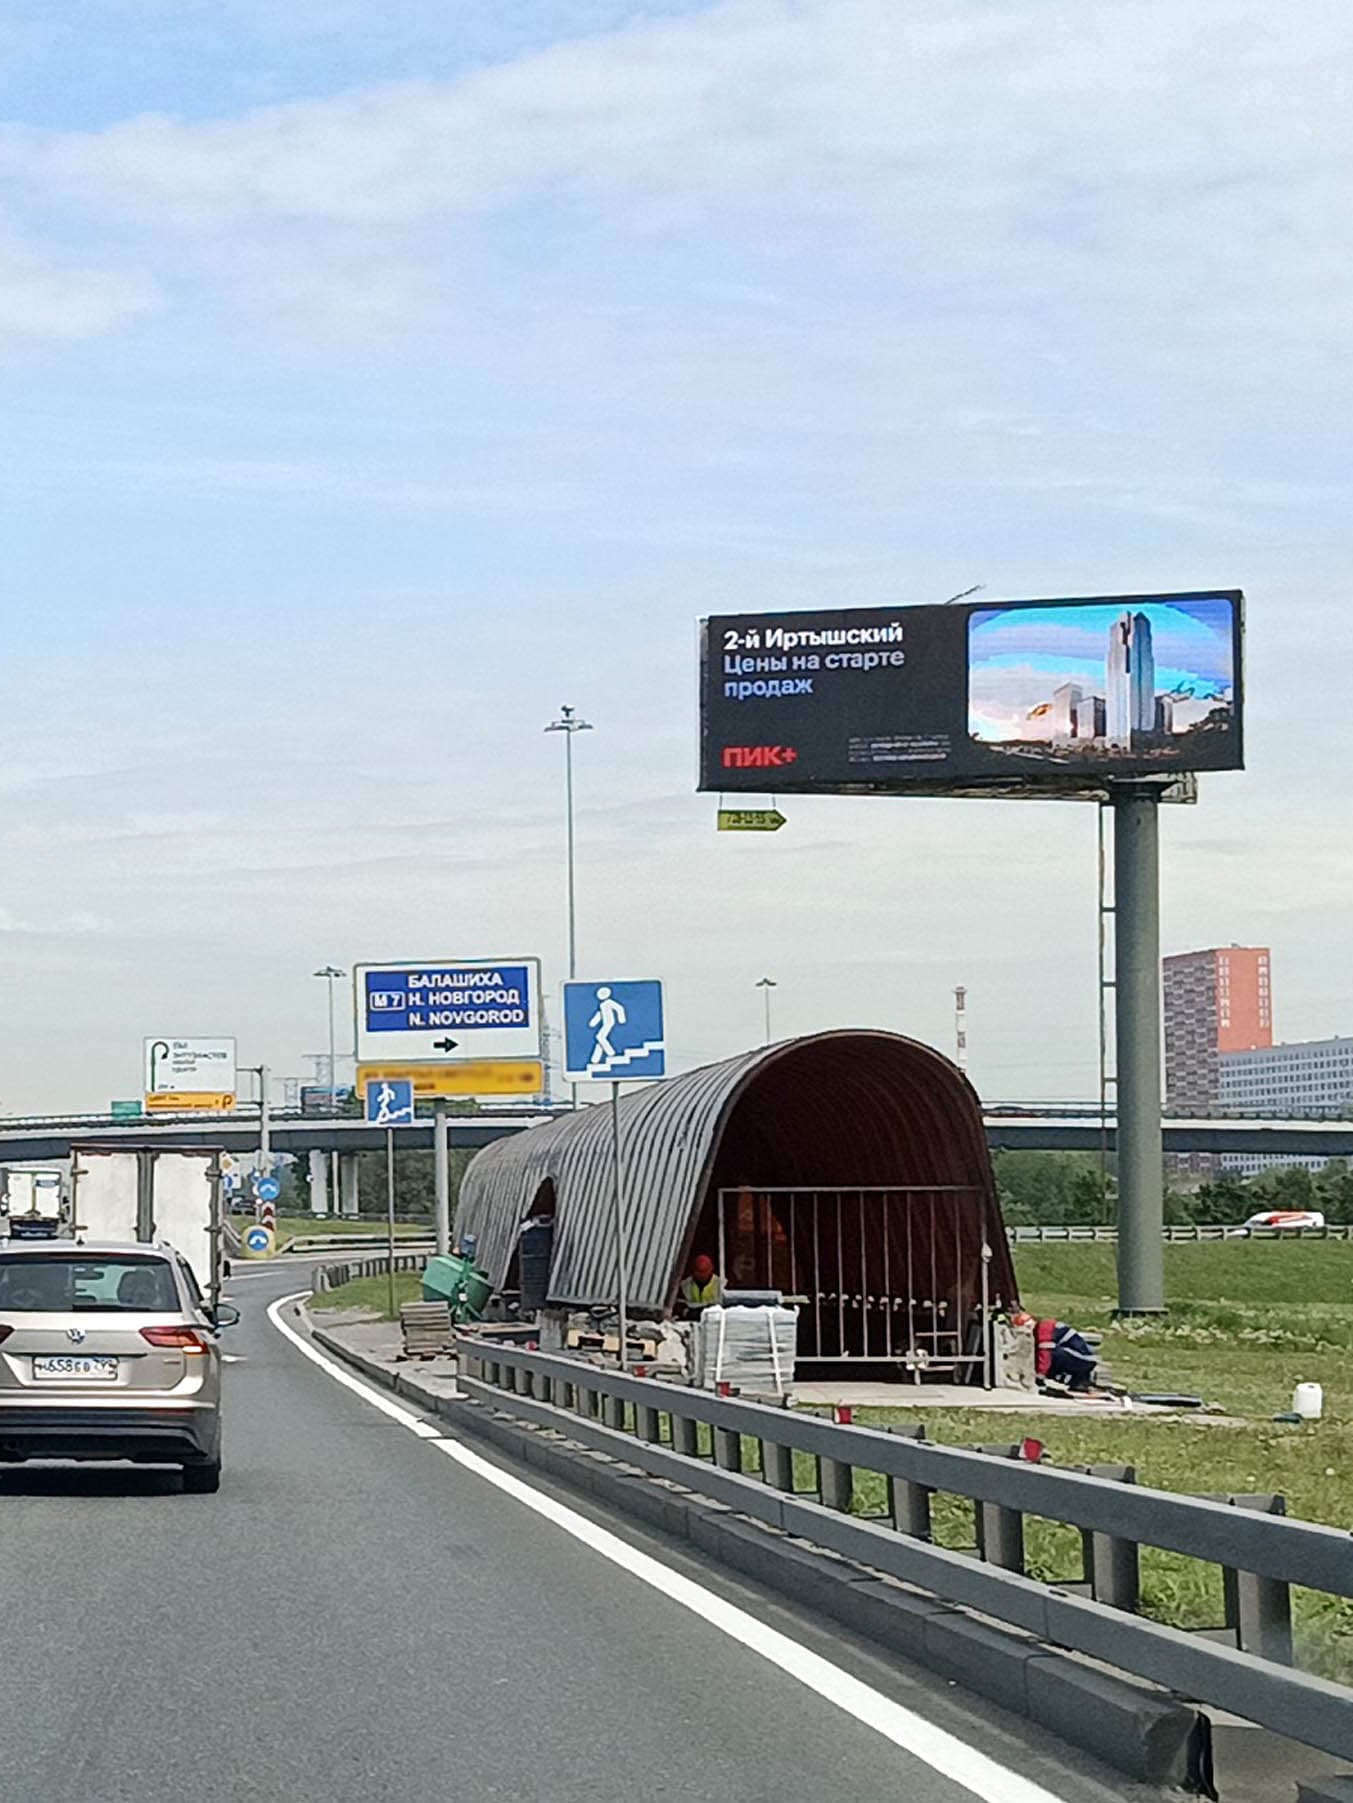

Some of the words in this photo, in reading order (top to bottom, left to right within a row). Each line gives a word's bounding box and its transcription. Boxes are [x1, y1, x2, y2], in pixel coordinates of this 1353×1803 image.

[723, 629, 760, 650] 2-й
[765, 622, 904, 651] Иртышский
[723, 654, 788, 676] Цены
[792, 657, 821, 671] на
[824, 650, 905, 671] старте
[723, 678, 815, 701] продаж
[407, 972, 504, 989] БАЛАШИХА
[408, 991, 425, 1006] Н.
[428, 988, 521, 1006] НОВГОРОД
[408, 1012, 426, 1026] N.
[428, 1009, 524, 1025] NOVGOROD
